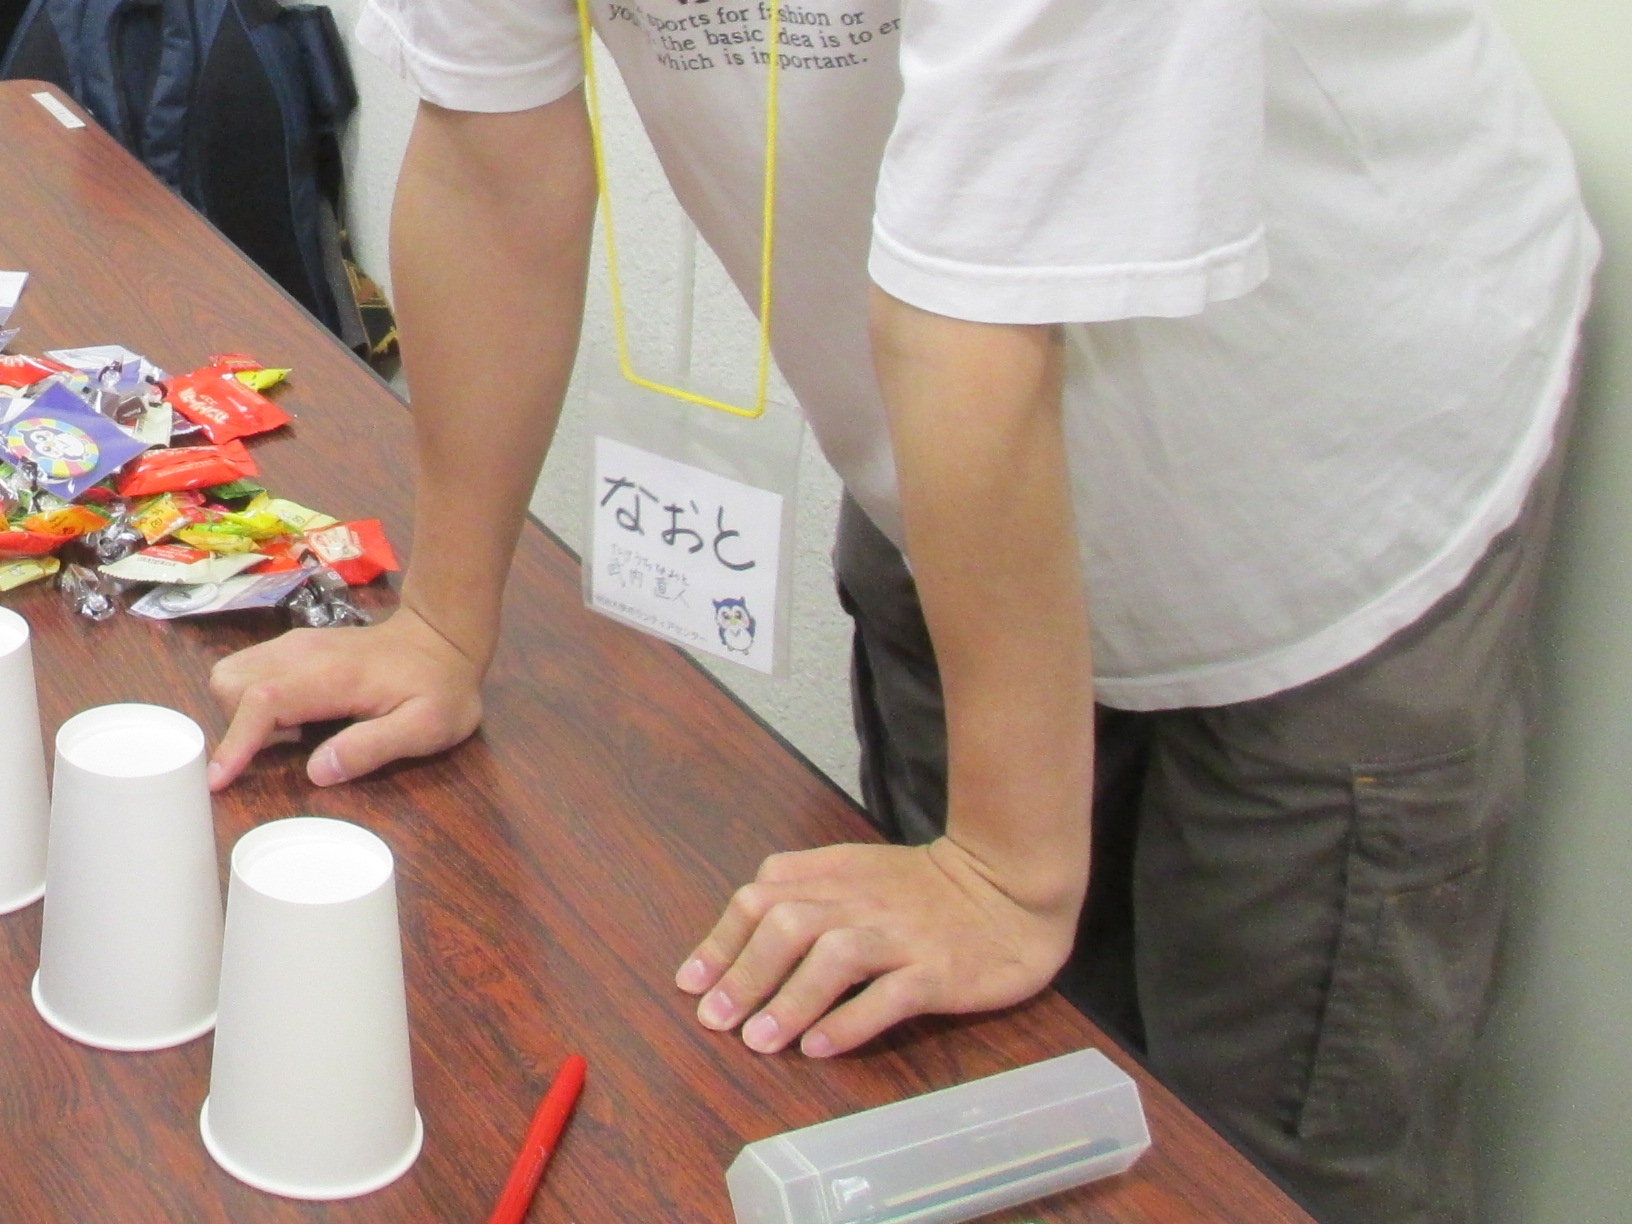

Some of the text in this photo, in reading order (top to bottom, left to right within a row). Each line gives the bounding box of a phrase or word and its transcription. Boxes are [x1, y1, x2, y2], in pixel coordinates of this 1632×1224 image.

[717, 6, 749, 24] for
[759, 2, 831, 27] fshion
[841, 12, 865, 26] or
[661, 35, 696, 51] the
[704, 25, 764, 46] basic
[778, 28, 814, 48] dea
[819, 30, 841, 48] is
[849, 31, 873, 46] to
[724, 48, 745, 65] is
[599, 476, 756, 571] なおと
